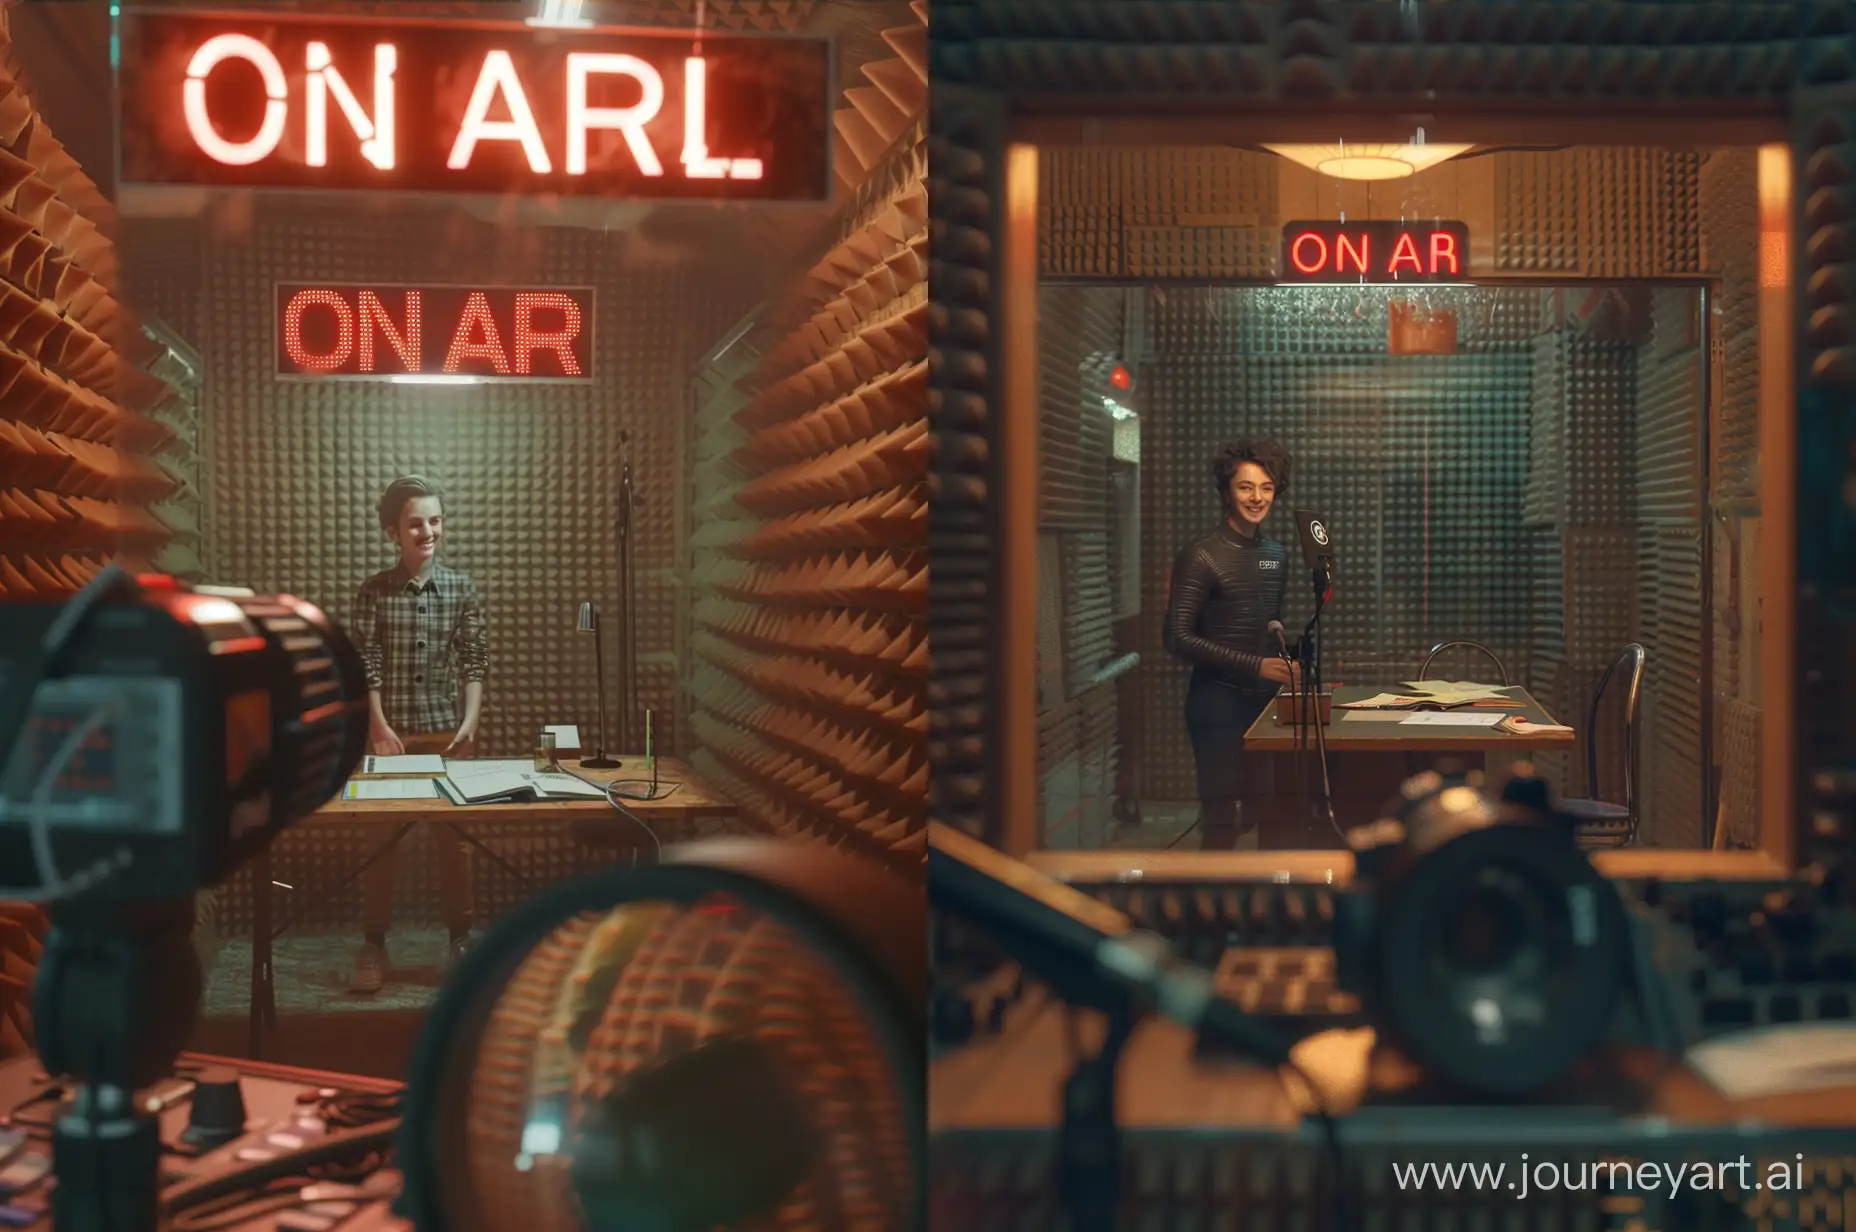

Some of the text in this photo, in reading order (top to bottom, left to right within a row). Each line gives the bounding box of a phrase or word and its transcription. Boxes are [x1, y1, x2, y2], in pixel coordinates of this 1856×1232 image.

[183, 32, 763, 180] ON ARL
[1292, 232, 1457, 274] ON AR
[284, 289, 582, 375] ON AR
